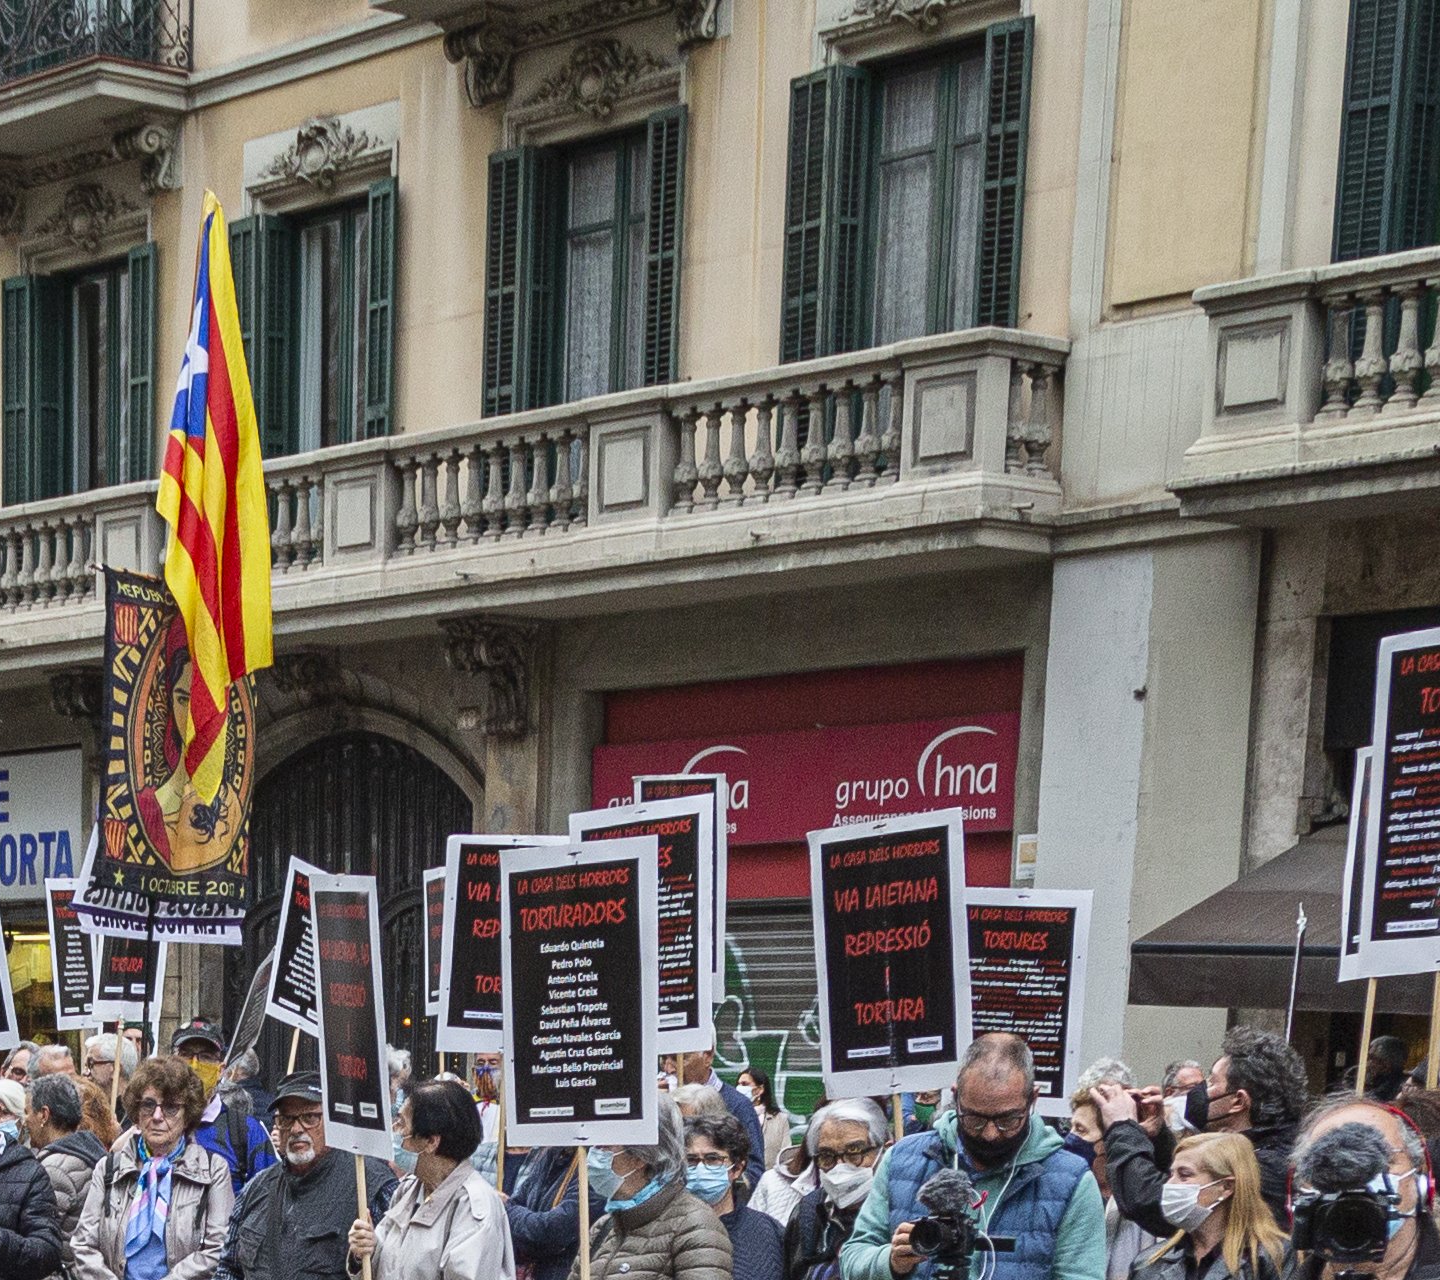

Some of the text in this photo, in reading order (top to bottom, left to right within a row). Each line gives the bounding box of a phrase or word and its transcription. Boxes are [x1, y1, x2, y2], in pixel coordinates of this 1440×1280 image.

[1401, 657, 1415, 675] LA
[835, 755, 997, 808] grupo hna
[467, 854, 477, 866] LA
[830, 839, 940, 869] LA CASA DELS HORRORS
[141, 875, 146, 891] 1
[517, 867, 629, 895] LA CASA DELS HORRORS
[468, 881, 491, 901] VIA
[834, 876, 938, 912] VIA LAIETANA
[520, 897, 626, 931] TORTURADORS
[970, 908, 1069, 923] LA CASA DELS HORRORS
[845, 919, 931, 956] REPRESSIÓ
[983, 930, 1049, 951] TORTURES
[540, 938, 605, 953] Eduardo Quintela
[551, 957, 592, 970] Pedro Polo
[548, 971, 598, 985] Antonio Creix
[884, 966, 891, 991] I
[549, 987, 598, 1000] Vicente Creix
[577, 1002, 608, 1013] Trapote
[855, 996, 925, 1025] TORTURA
[540, 1015, 611, 1030] David Peña Álvarez
[594, 1030, 621, 1041] García
[568, 1048, 585, 1058] Cruz
[586, 1045, 613, 1057] García
[563, 1062, 582, 1073] Bello
[583, 1059, 624, 1072] Provincial
[571, 1076, 597, 1088] García
